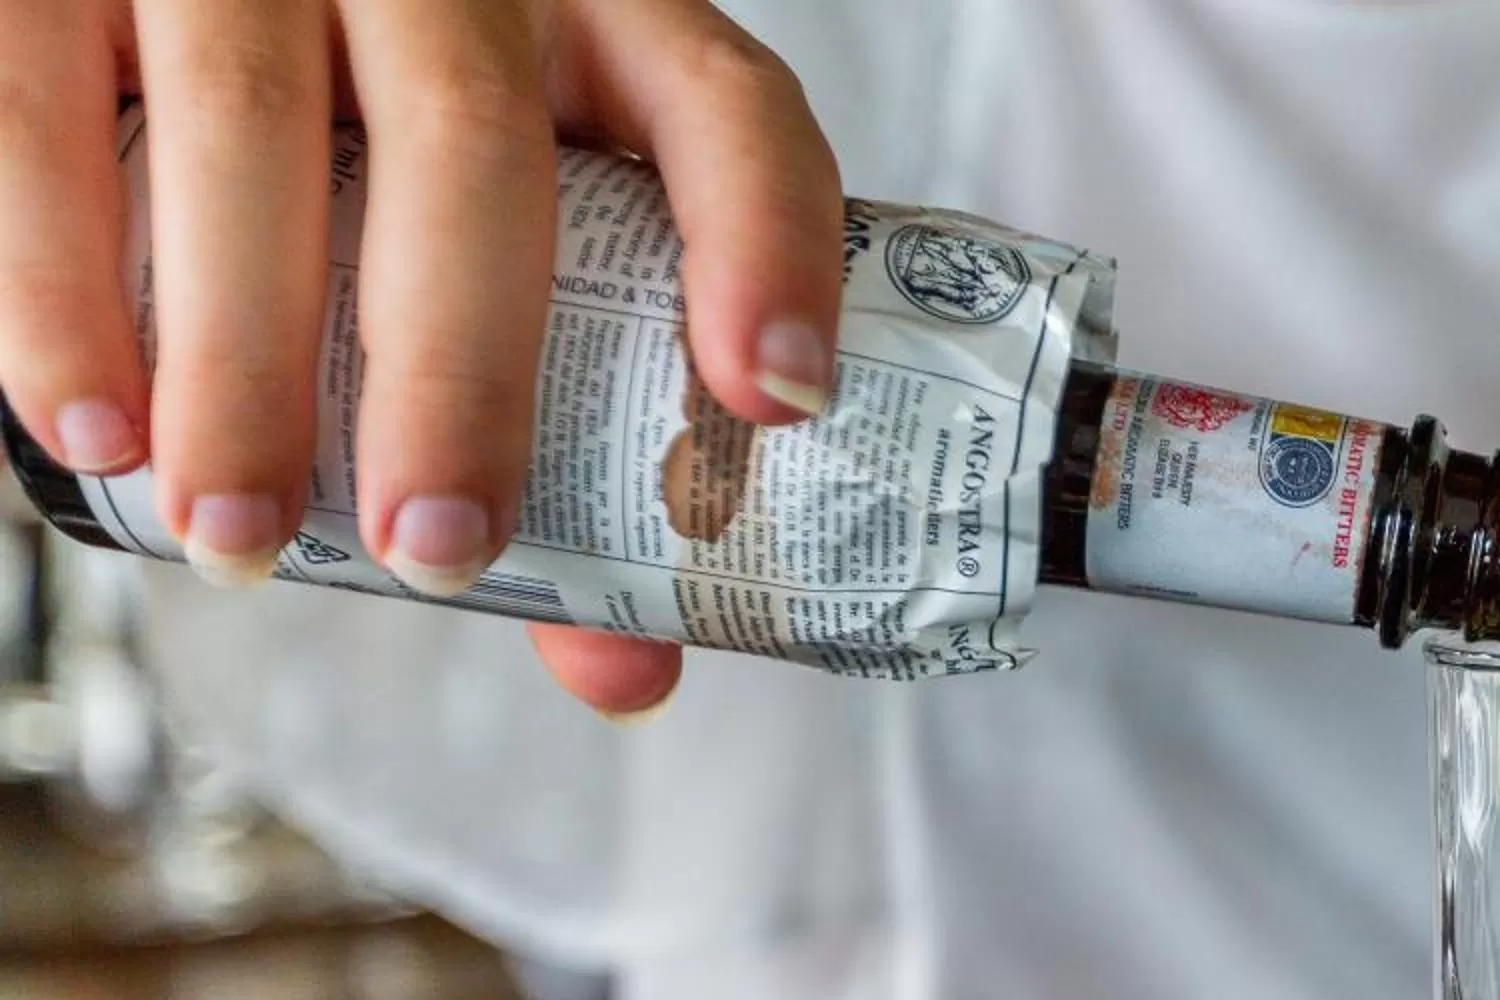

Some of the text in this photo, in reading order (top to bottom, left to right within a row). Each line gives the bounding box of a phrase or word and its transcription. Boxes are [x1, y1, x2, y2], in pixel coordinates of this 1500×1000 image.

[552, 275, 686, 311] NIDAD & TOB
[1122, 416, 1144, 480] AROMATIC
[1118, 483, 1133, 530] BITTERS
[1181, 461, 1196, 507] MAJESTY
[1333, 488, 1357, 568] BITTERS
